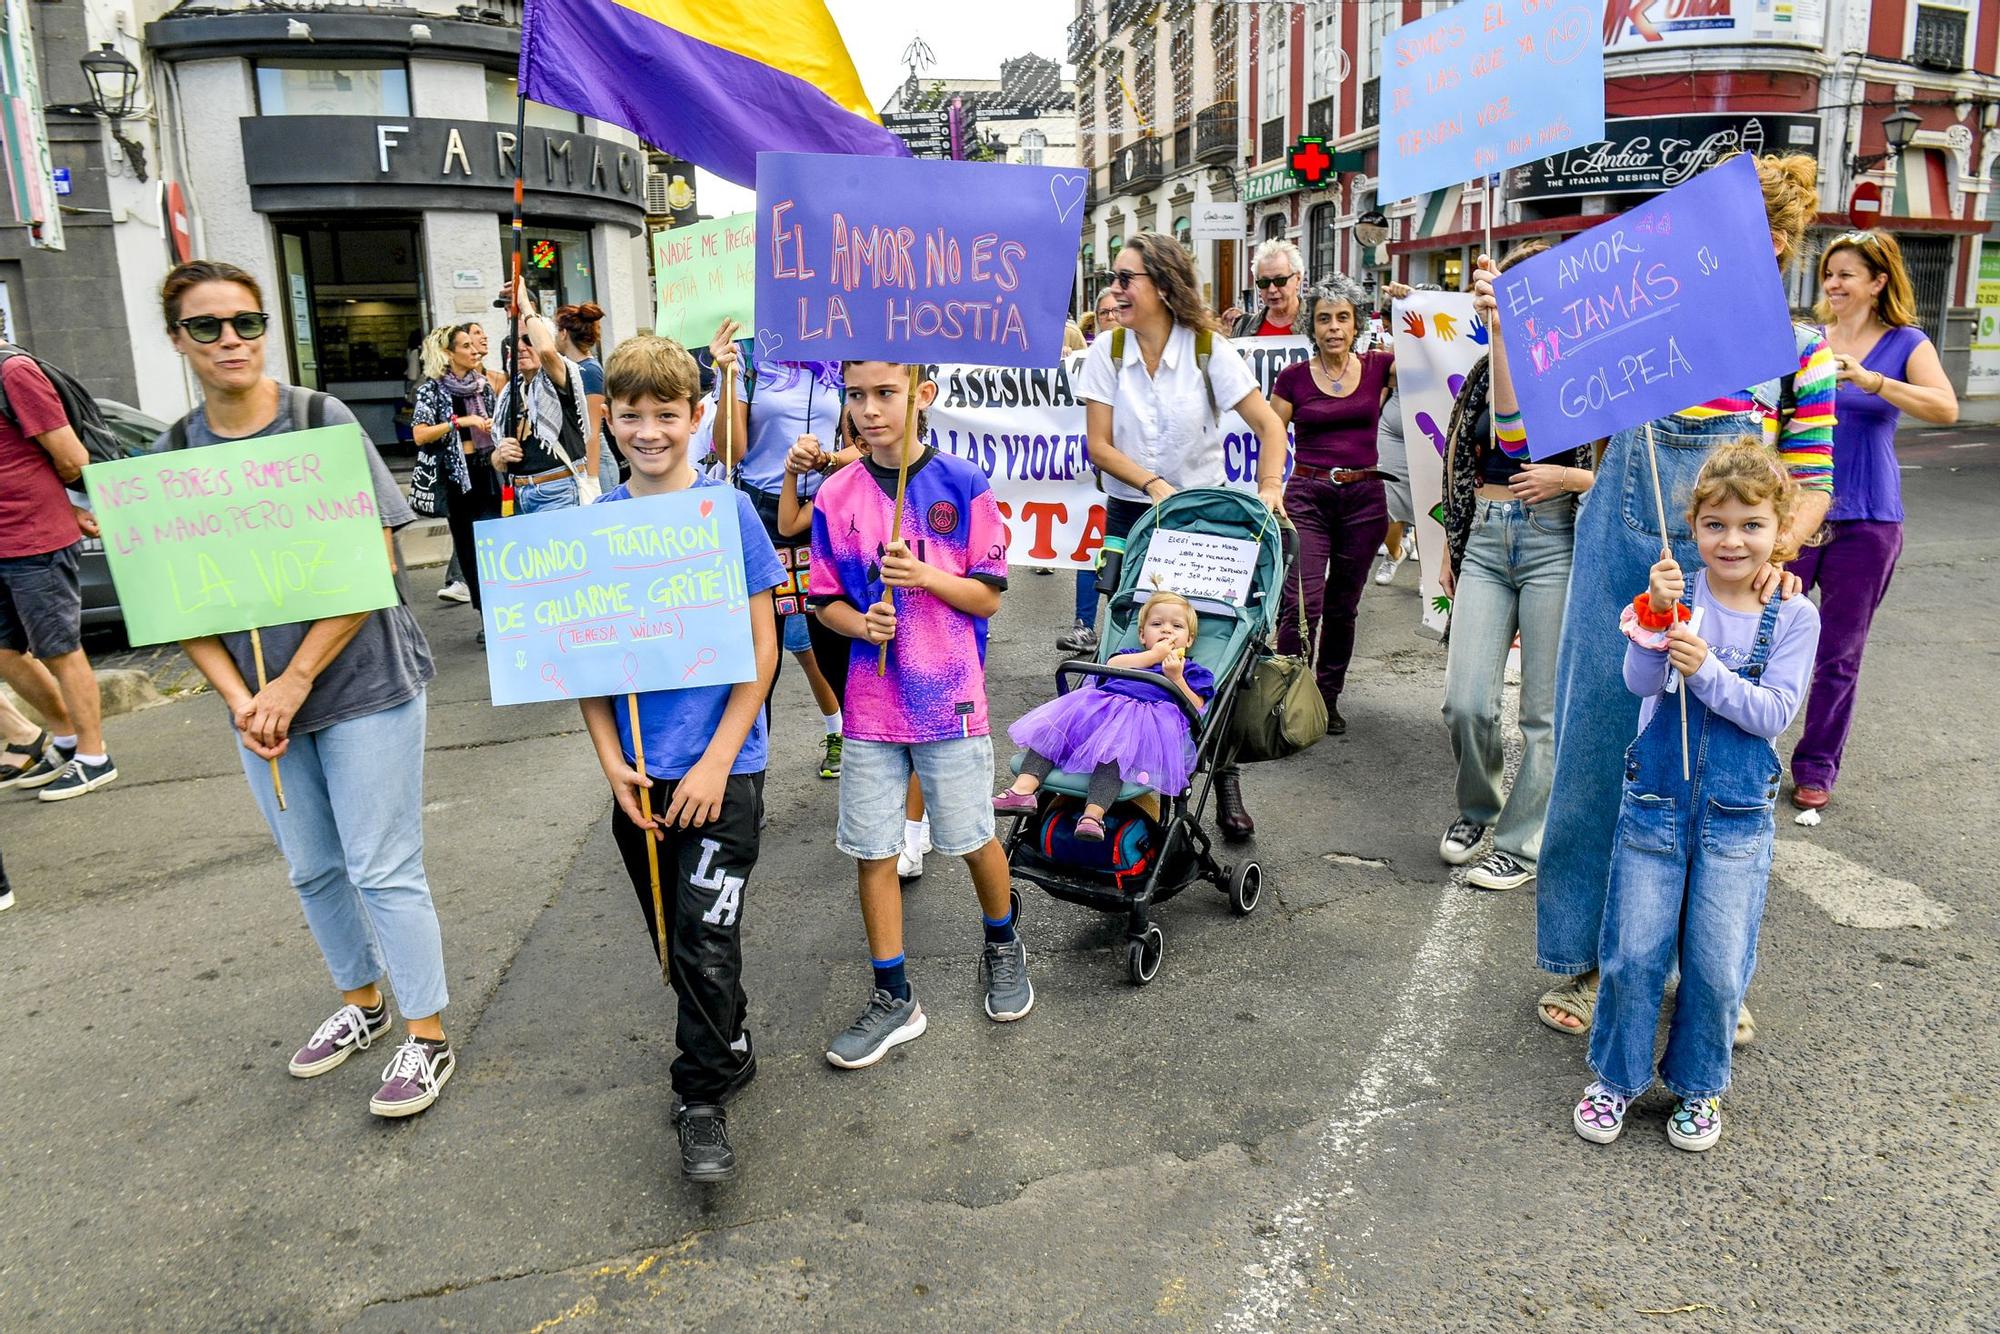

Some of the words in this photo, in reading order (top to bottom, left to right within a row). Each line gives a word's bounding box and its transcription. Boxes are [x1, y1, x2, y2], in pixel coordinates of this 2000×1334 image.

[1395, 20, 1466, 68] SOMOS
[1484, 4, 1511, 32] EL
[1426, 65, 1461, 96] LAS
[1471, 48, 1508, 79] QUE
[1551, 19, 1580, 44] NO
[1476, 96, 1518, 129] VOZ
[1547, 179, 1564, 188] THE
[1569, 175, 1609, 185] ITALIAN
[1617, 172, 1660, 183] DESIGN
[702, 232, 719, 258] ME
[772, 200, 815, 281] EL
[831, 213, 917, 292] AMOR
[926, 227, 963, 288] NO
[972, 233, 1026, 292] ES
[1506, 276, 1544, 316] EL
[1558, 230, 1645, 289] AMOR
[798, 295, 854, 341] LA
[1557, 260, 1681, 340] JAMÁS
[1559, 335, 1693, 419] GOLPEA
[97, 476, 149, 510] NOS
[240, 454, 324, 493] ROMPER
[114, 526, 145, 555] LA
[307, 490, 375, 523] NUNCA
[591, 518, 720, 559] TRATARON
[166, 552, 238, 614] LA
[251, 540, 352, 608] VOZ
[493, 602, 526, 634] DE
